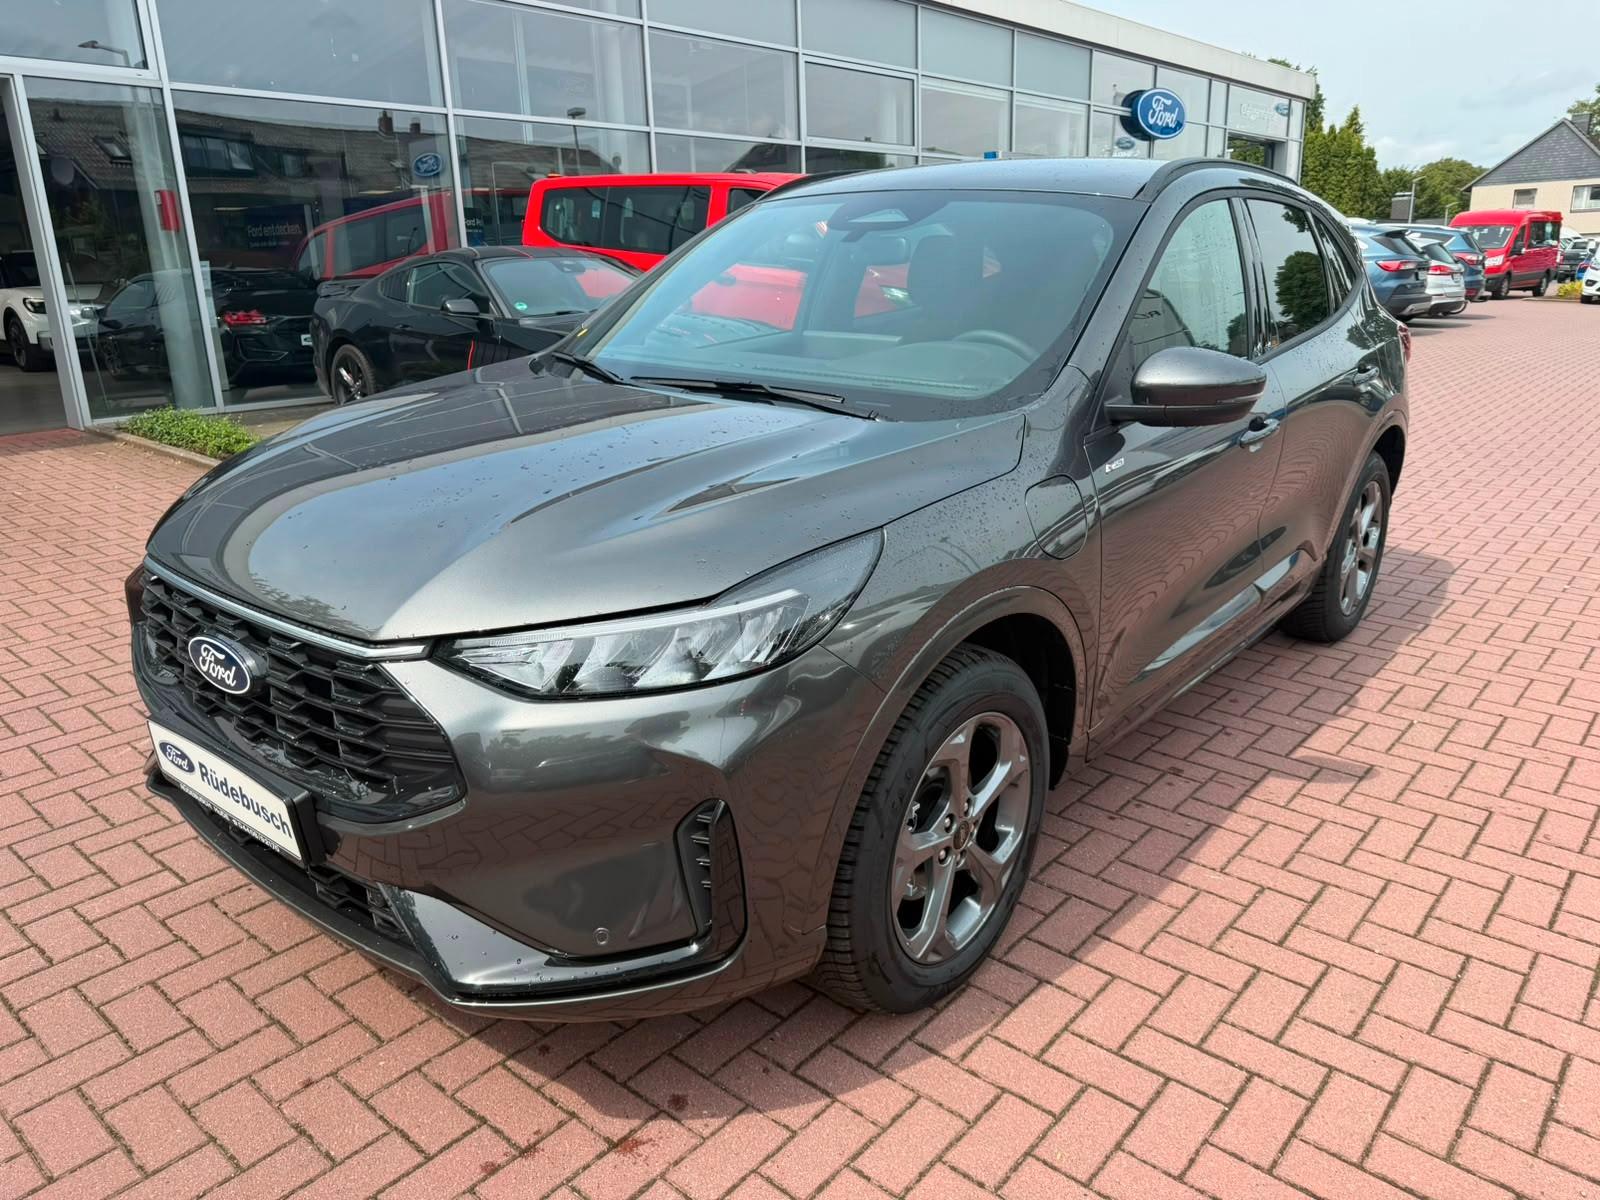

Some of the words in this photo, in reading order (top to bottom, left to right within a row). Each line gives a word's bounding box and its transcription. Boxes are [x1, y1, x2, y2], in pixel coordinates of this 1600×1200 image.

[1148, 96, 1179, 128] Ford
[248, 224, 263, 237] Ford
[199, 643, 236, 687] Ford
[166, 744, 190, 772] Ford
[198, 761, 293, 840] Rüdebusch
